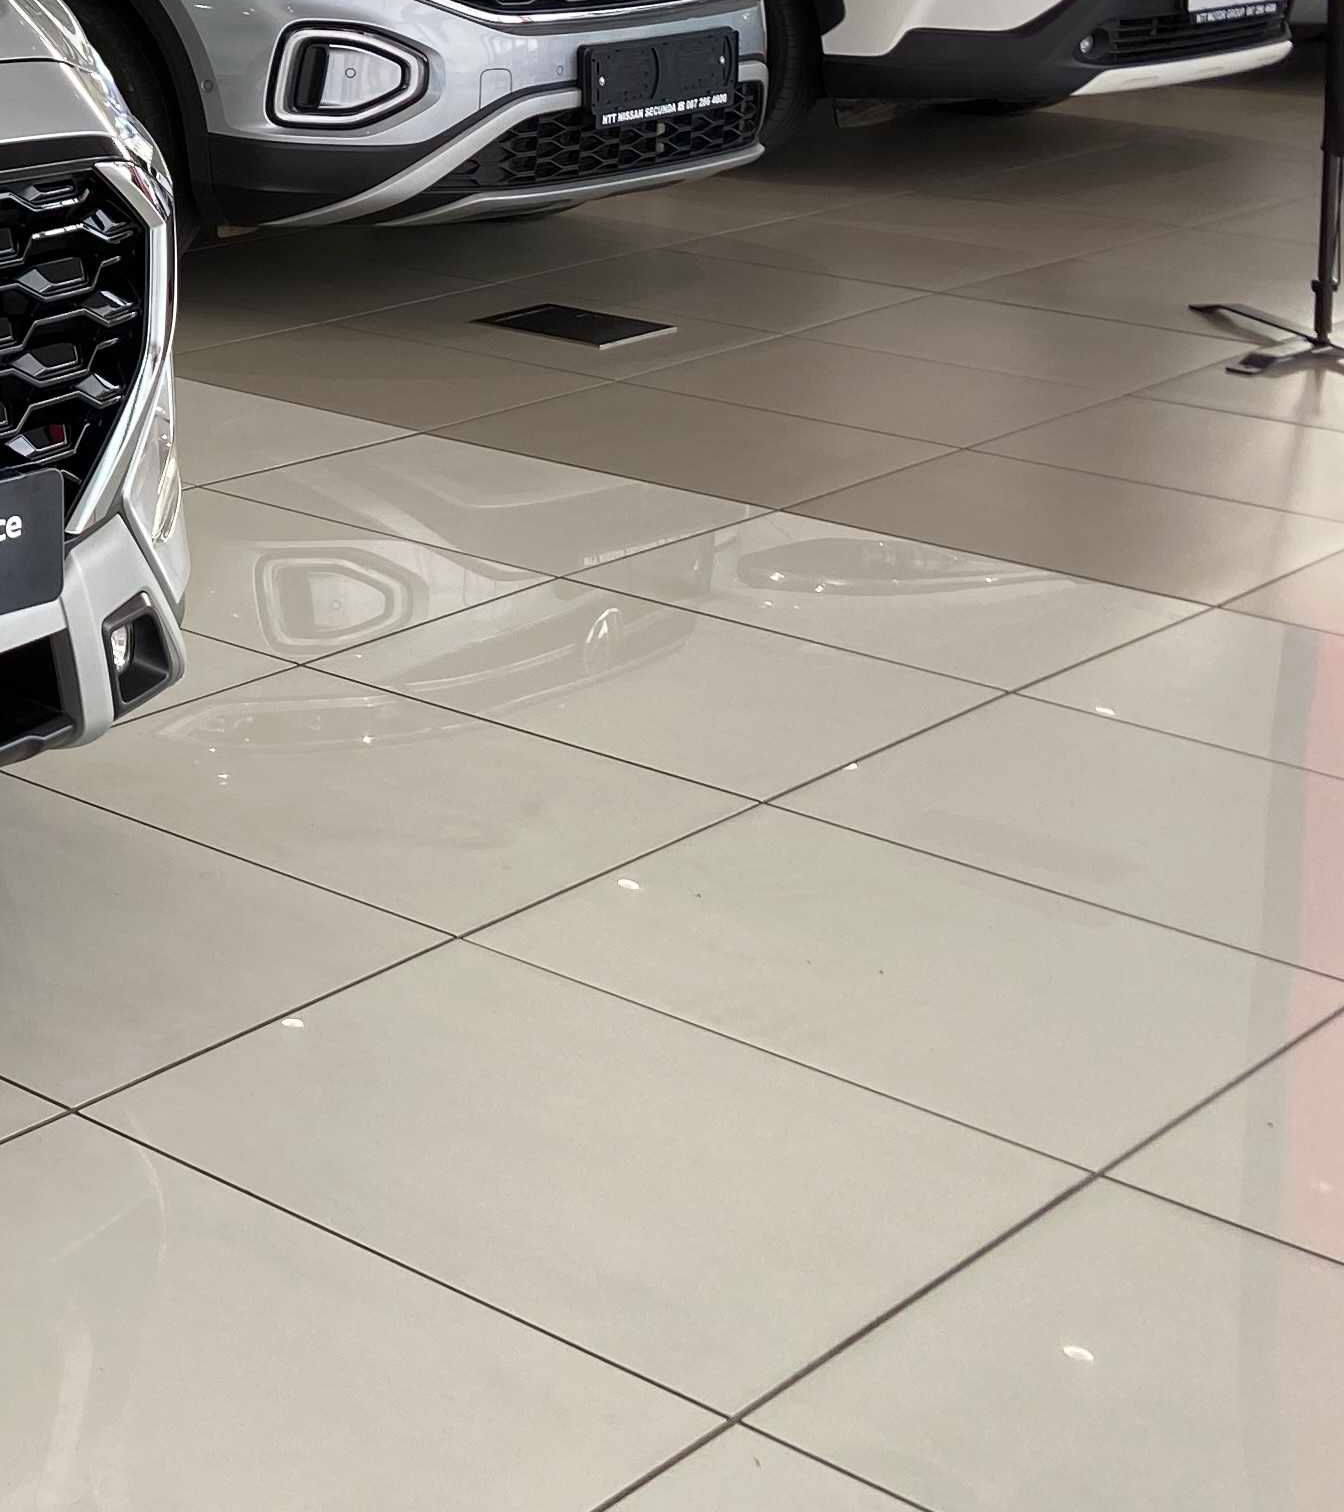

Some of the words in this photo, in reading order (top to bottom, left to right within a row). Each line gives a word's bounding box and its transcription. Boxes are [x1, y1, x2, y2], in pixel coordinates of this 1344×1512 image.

[602, 112, 618, 125] NTT
[617, 108, 644, 123] NISSAN
[644, 103, 677, 118] SECUNDA
